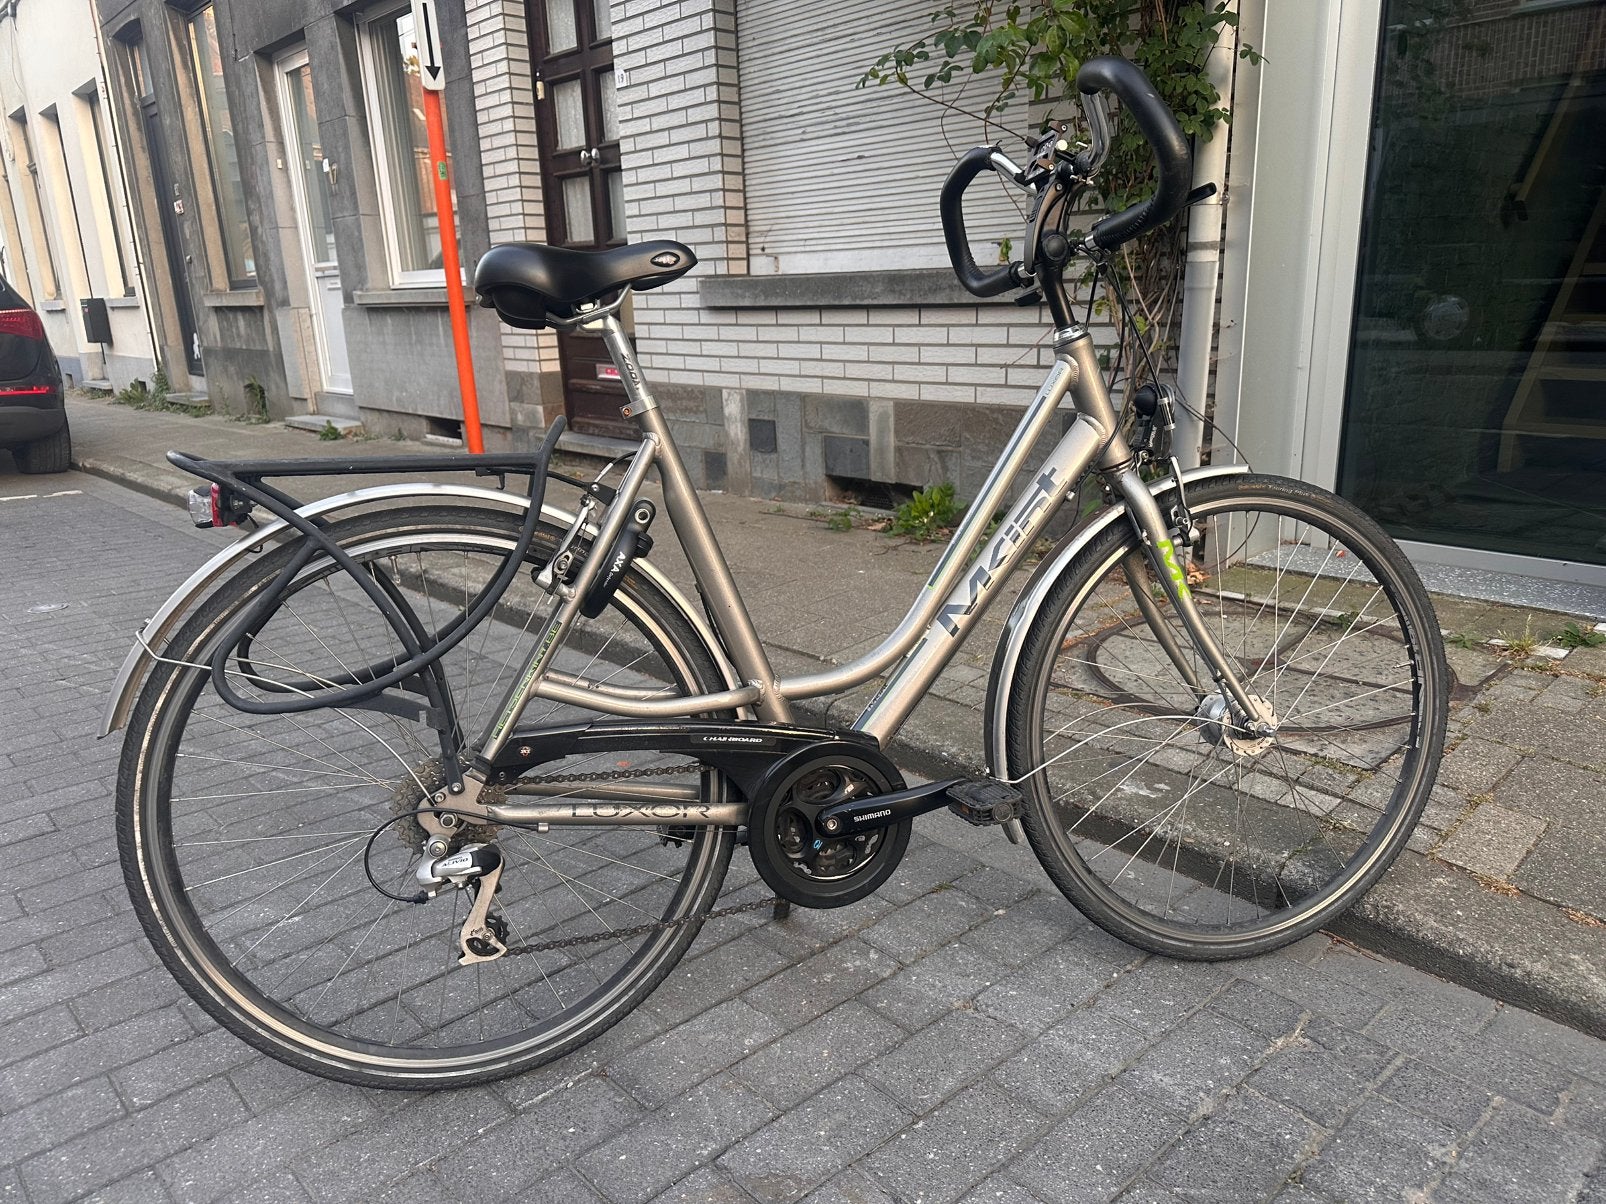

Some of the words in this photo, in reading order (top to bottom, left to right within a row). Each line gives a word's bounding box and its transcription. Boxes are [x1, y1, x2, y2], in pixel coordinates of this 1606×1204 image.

[610, 551, 626, 572] AXA
[571, 803, 710, 819] LUXOR
[853, 809, 892, 823] SHIMANO
